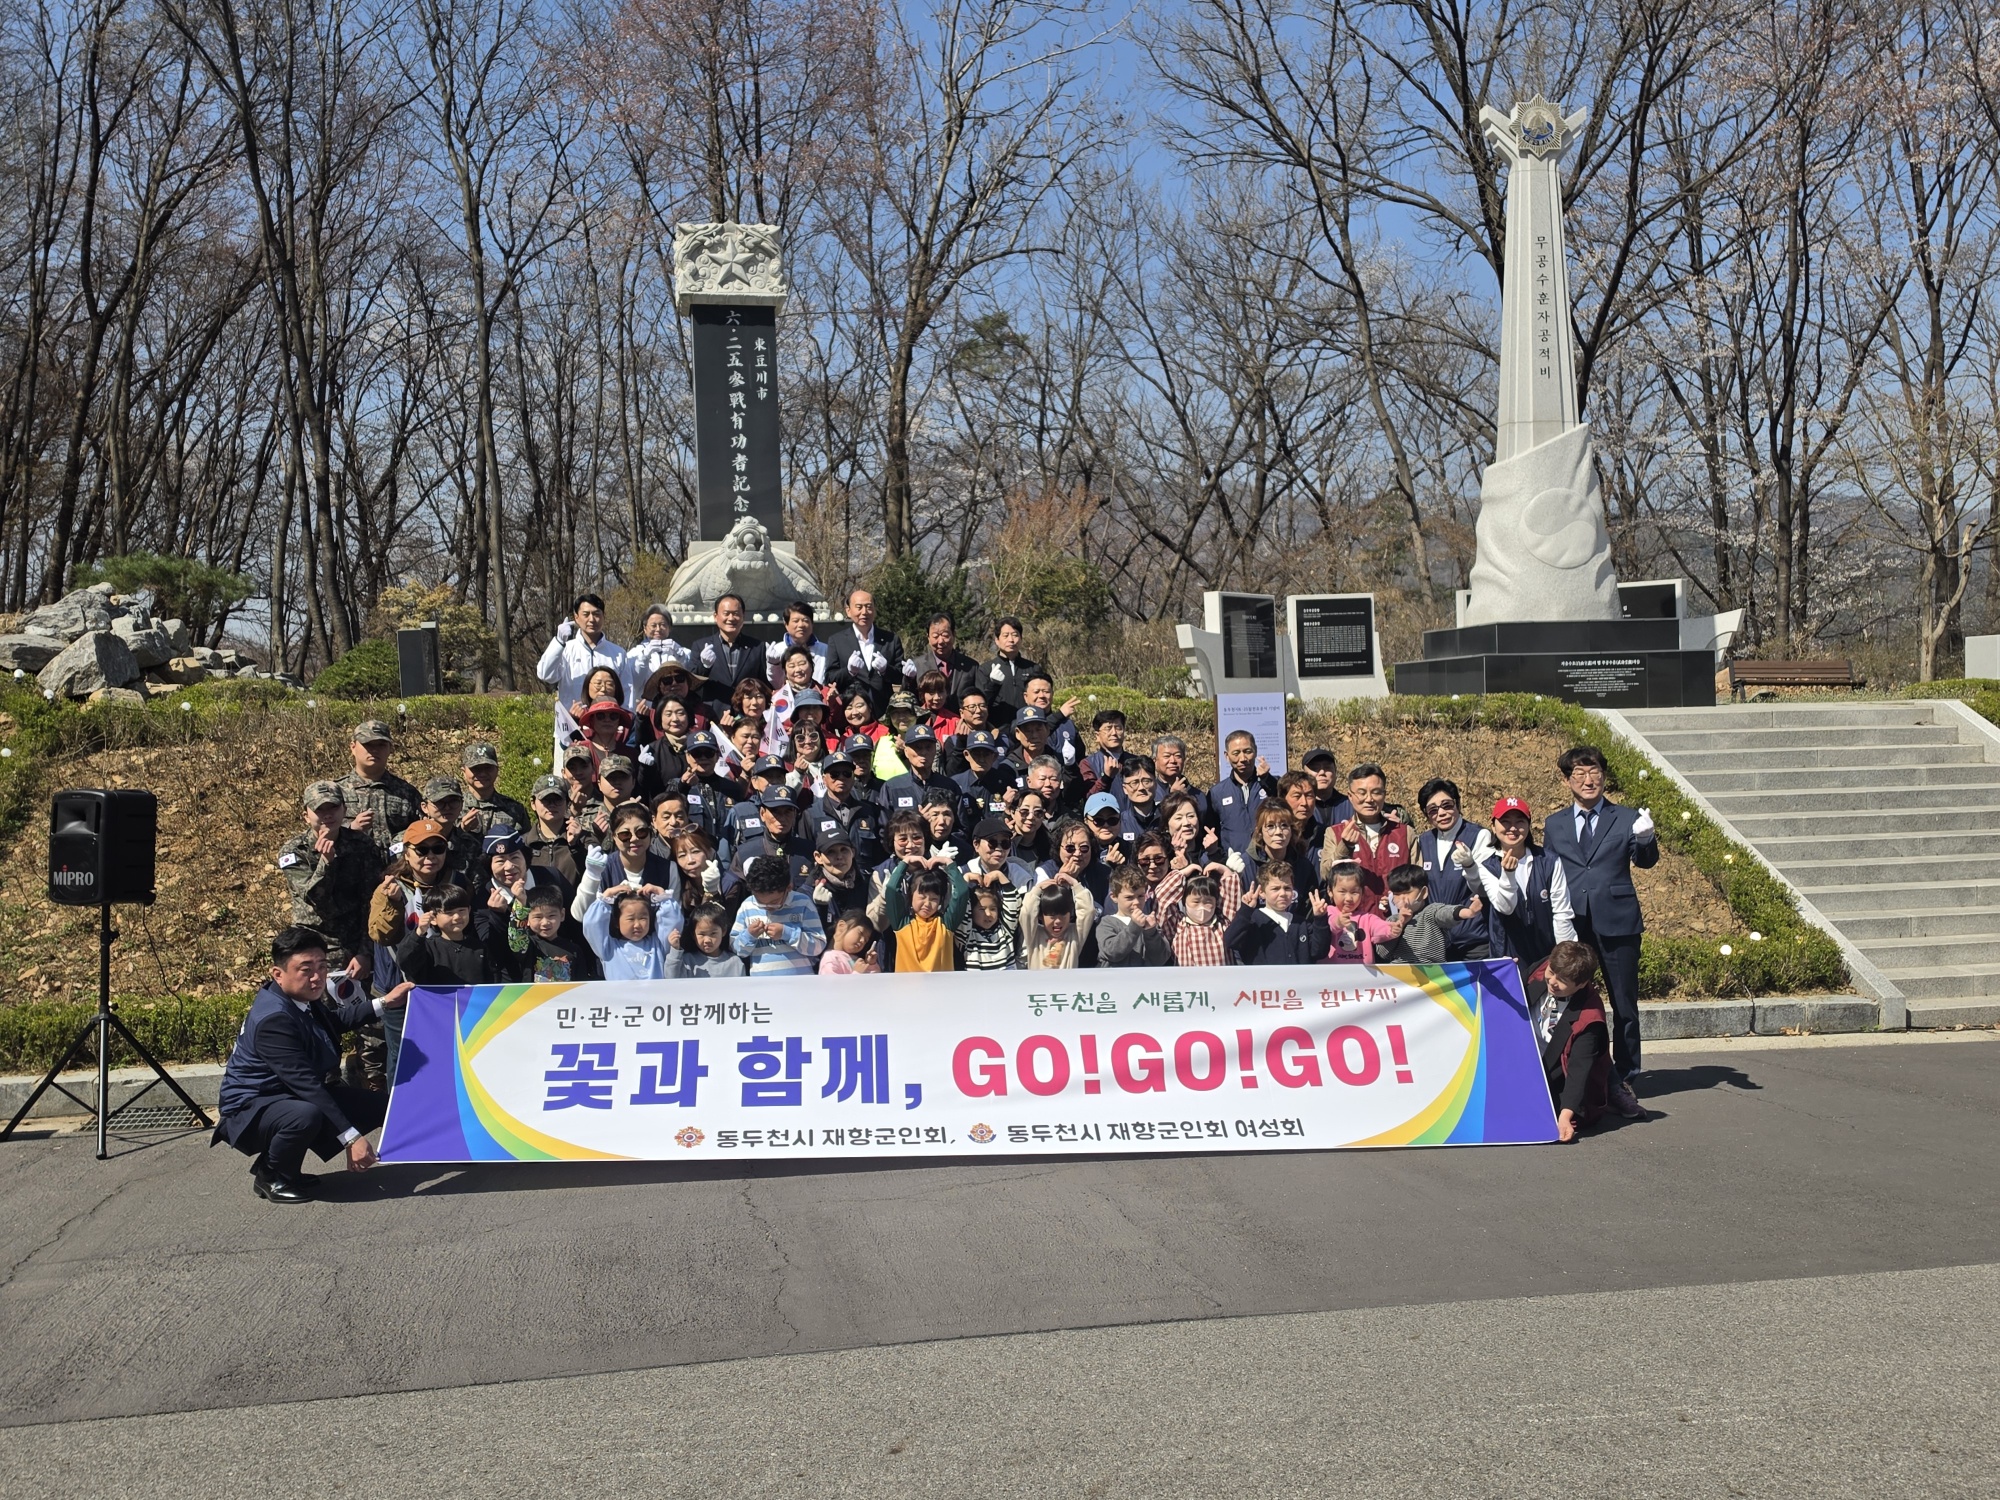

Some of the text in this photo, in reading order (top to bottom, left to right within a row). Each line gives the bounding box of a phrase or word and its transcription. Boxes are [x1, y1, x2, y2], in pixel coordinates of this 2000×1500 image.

[1534, 235, 1551, 379] 무공수훈자공적비
[753, 336, 769, 401] 東豆川市
[725, 310, 752, 524] 六·二五參戰有功者記念
[53, 870, 94, 886] MIPRO
[680, 1002, 773, 1026] 함께하는
[1027, 987, 1398, 1017] 동두천을 새롭게, 시민을 힘나게!
[543, 1033, 923, 1111] 꽃과 함께,
[716, 1126, 957, 1149] 동두천시 재향군인회,
[1007, 1117, 1305, 1144] 동두천시 재향군인회 여성회
